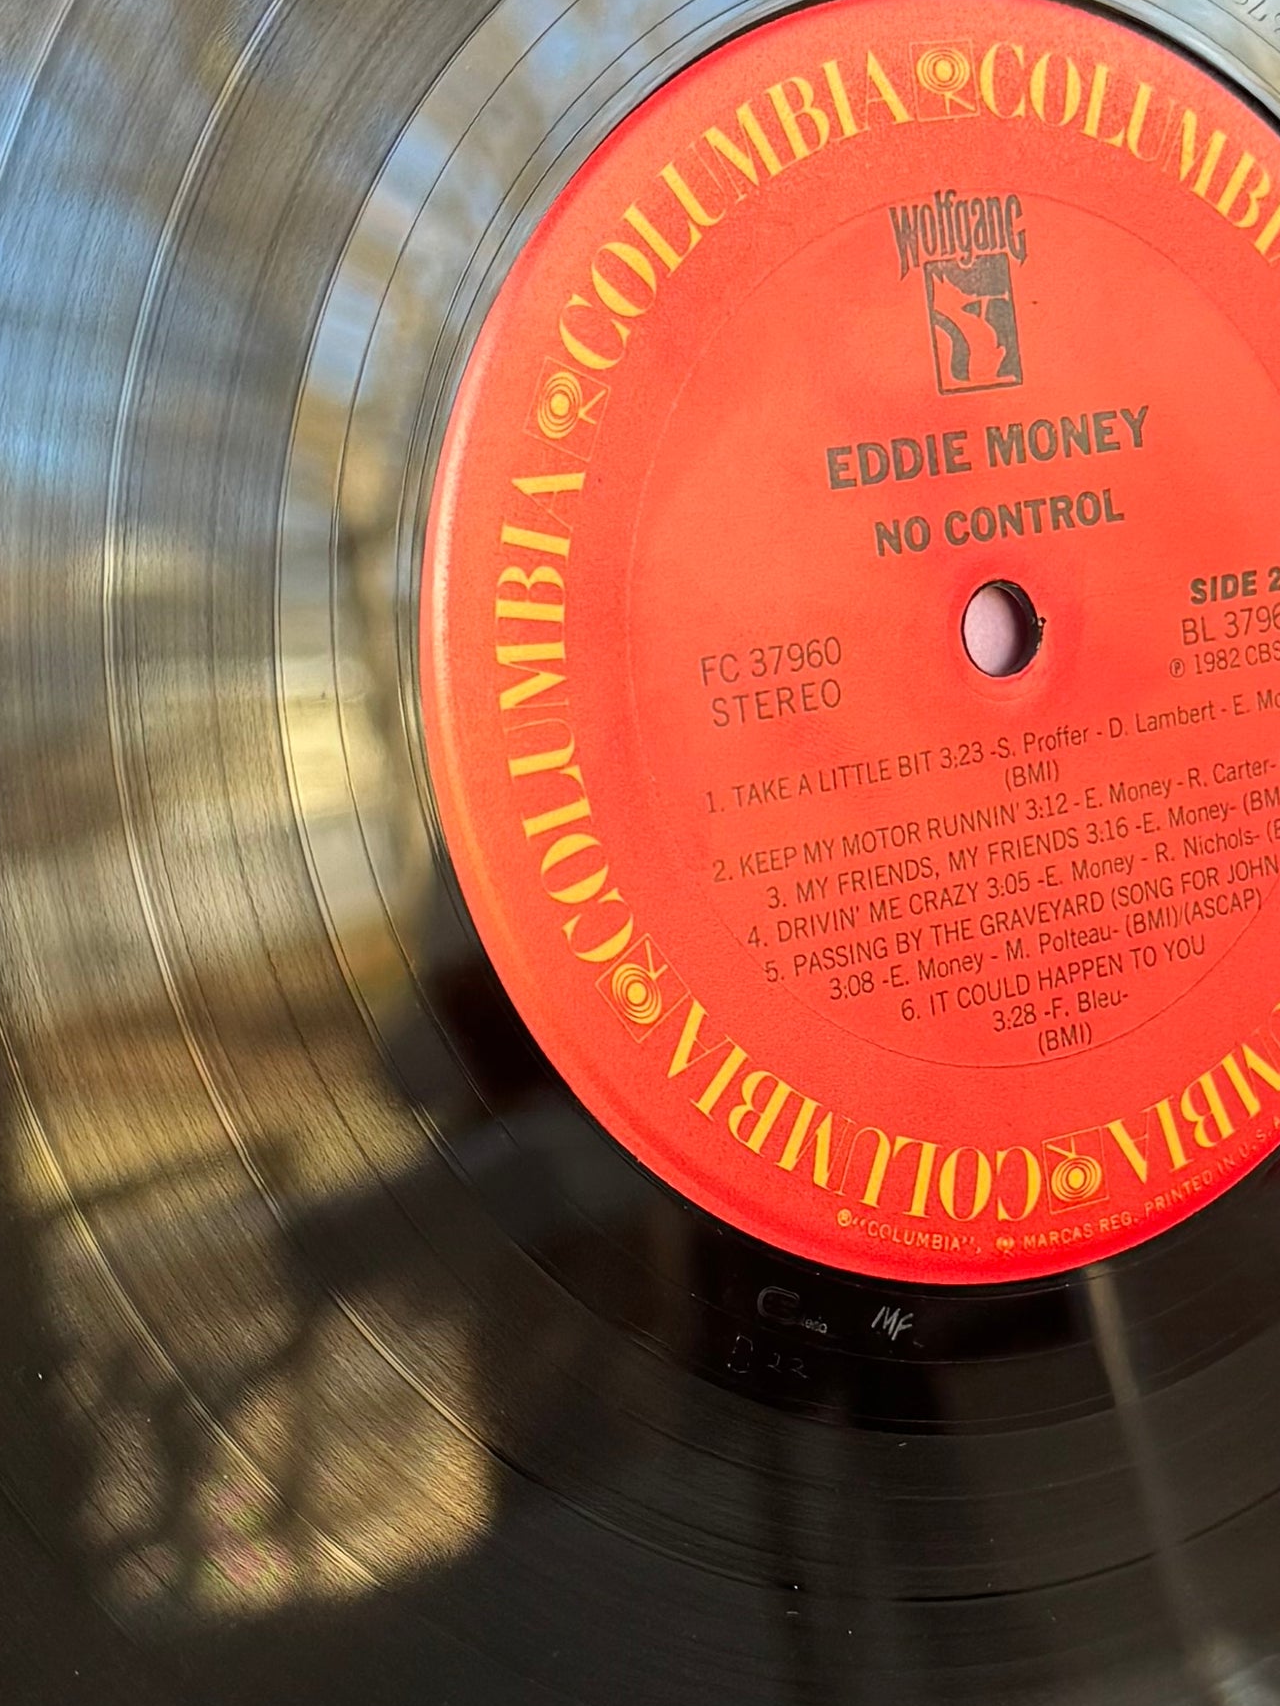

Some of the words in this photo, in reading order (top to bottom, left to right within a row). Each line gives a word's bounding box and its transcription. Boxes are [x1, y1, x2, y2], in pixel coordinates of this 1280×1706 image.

[557, 55, 912, 372] COLUMBIA
[826, 430, 972, 490] EDDIE
[986, 405, 1149, 468] MONEY
[875, 517, 931, 557] NO
[944, 488, 1125, 546] CONTROL
[1189, 568, 1258, 606] SIDE
[701, 654, 740, 686] FC
[749, 636, 841, 677] 37960
[1181, 617, 1215, 646] BL
[1194, 648, 1241, 675] 1982
[497, 466, 637, 965] COLUMBIA
[711, 678, 841, 727] STEREO
[706, 791, 725, 813] 1.
[731, 777, 791, 807] TAKE
[798, 774, 812, 796] A
[819, 759, 892, 792] LITTLE
[899, 751, 933, 778] BIT
[939, 741, 984, 769] 3:23
[1023, 725, 1089, 754] Proffer
[1109, 717, 1128, 739] D.
[1136, 700, 1216, 733] Lambert
[1233, 694, 1250, 716] E.
[1005, 759, 1059, 792] (BMI)
[901, 998, 920, 1021] 6.
[930, 991, 948, 1016] IT
[957, 974, 1030, 1010] COULD
[1038, 953, 1123, 991] HAPPEN
[1131, 946, 1157, 969] TO
[1164, 935, 1205, 962] YOU
[992, 1003, 1037, 1033] 3:28
[1038, 1021, 1092, 1055] (BMI)
[671, 996, 1044, 1223] COLUMBIA
[1023, 1222, 1093, 1251] MARCAS
[1099, 1212, 1139, 1234] REG.
[1144, 1169, 1213, 1218] PRINTED
